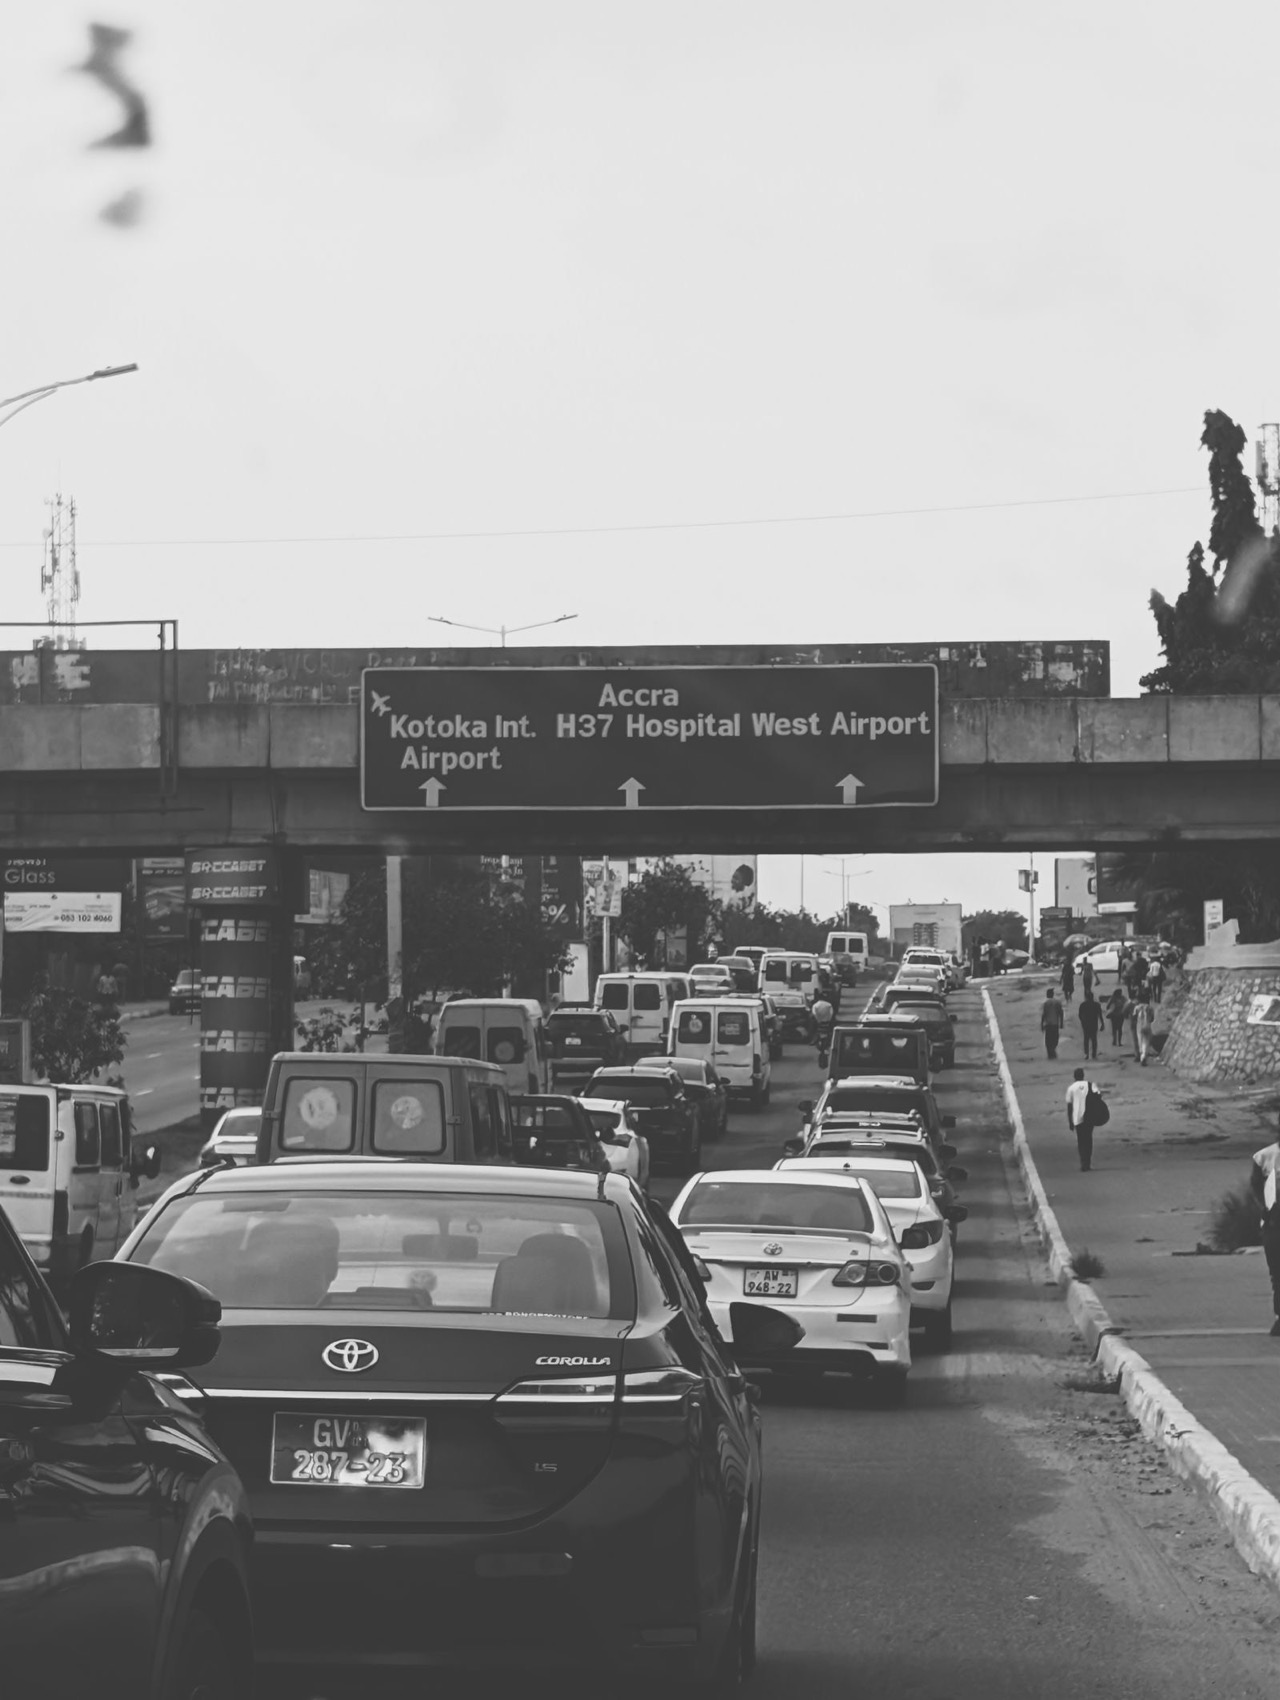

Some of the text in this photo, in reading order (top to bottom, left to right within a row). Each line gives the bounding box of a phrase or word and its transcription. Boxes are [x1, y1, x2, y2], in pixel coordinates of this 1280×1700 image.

[598, 683, 679, 707] Accra
[390, 715, 537, 739] Kotoka Int.
[556, 712, 741, 743] H37 Hospital
[751, 711, 931, 741] West Airport
[400, 746, 503, 775] Airport
[5, 868, 55, 884] Glass
[763, 1271, 779, 1281] AW
[535, 1356, 611, 1366] COROLLA
[313, 1418, 350, 1448] GV
[291, 1450, 406, 1483] 287-23
